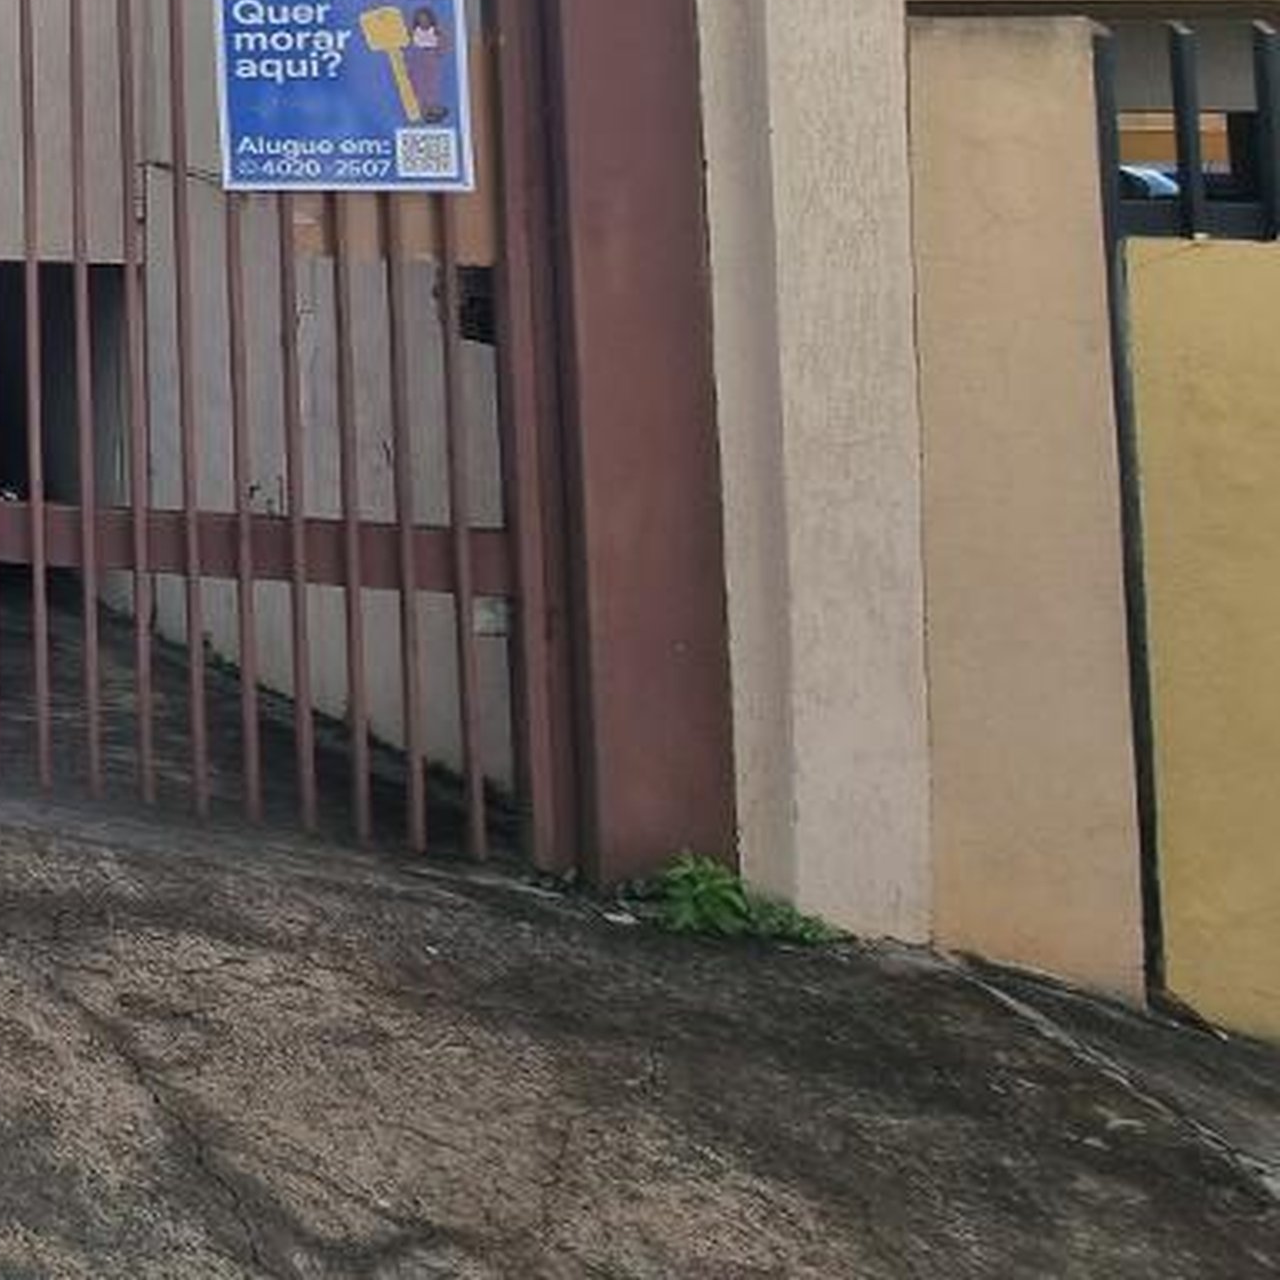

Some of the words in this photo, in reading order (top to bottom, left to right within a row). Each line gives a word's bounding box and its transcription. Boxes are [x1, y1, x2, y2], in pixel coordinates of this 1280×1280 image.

[233, 29, 351, 52] morar
[235, 53, 342, 83] aqui?
[238, 136, 334, 158] Alugue
[261, 158, 321, 177] 4020
[333, 159, 391, 177] 2507
